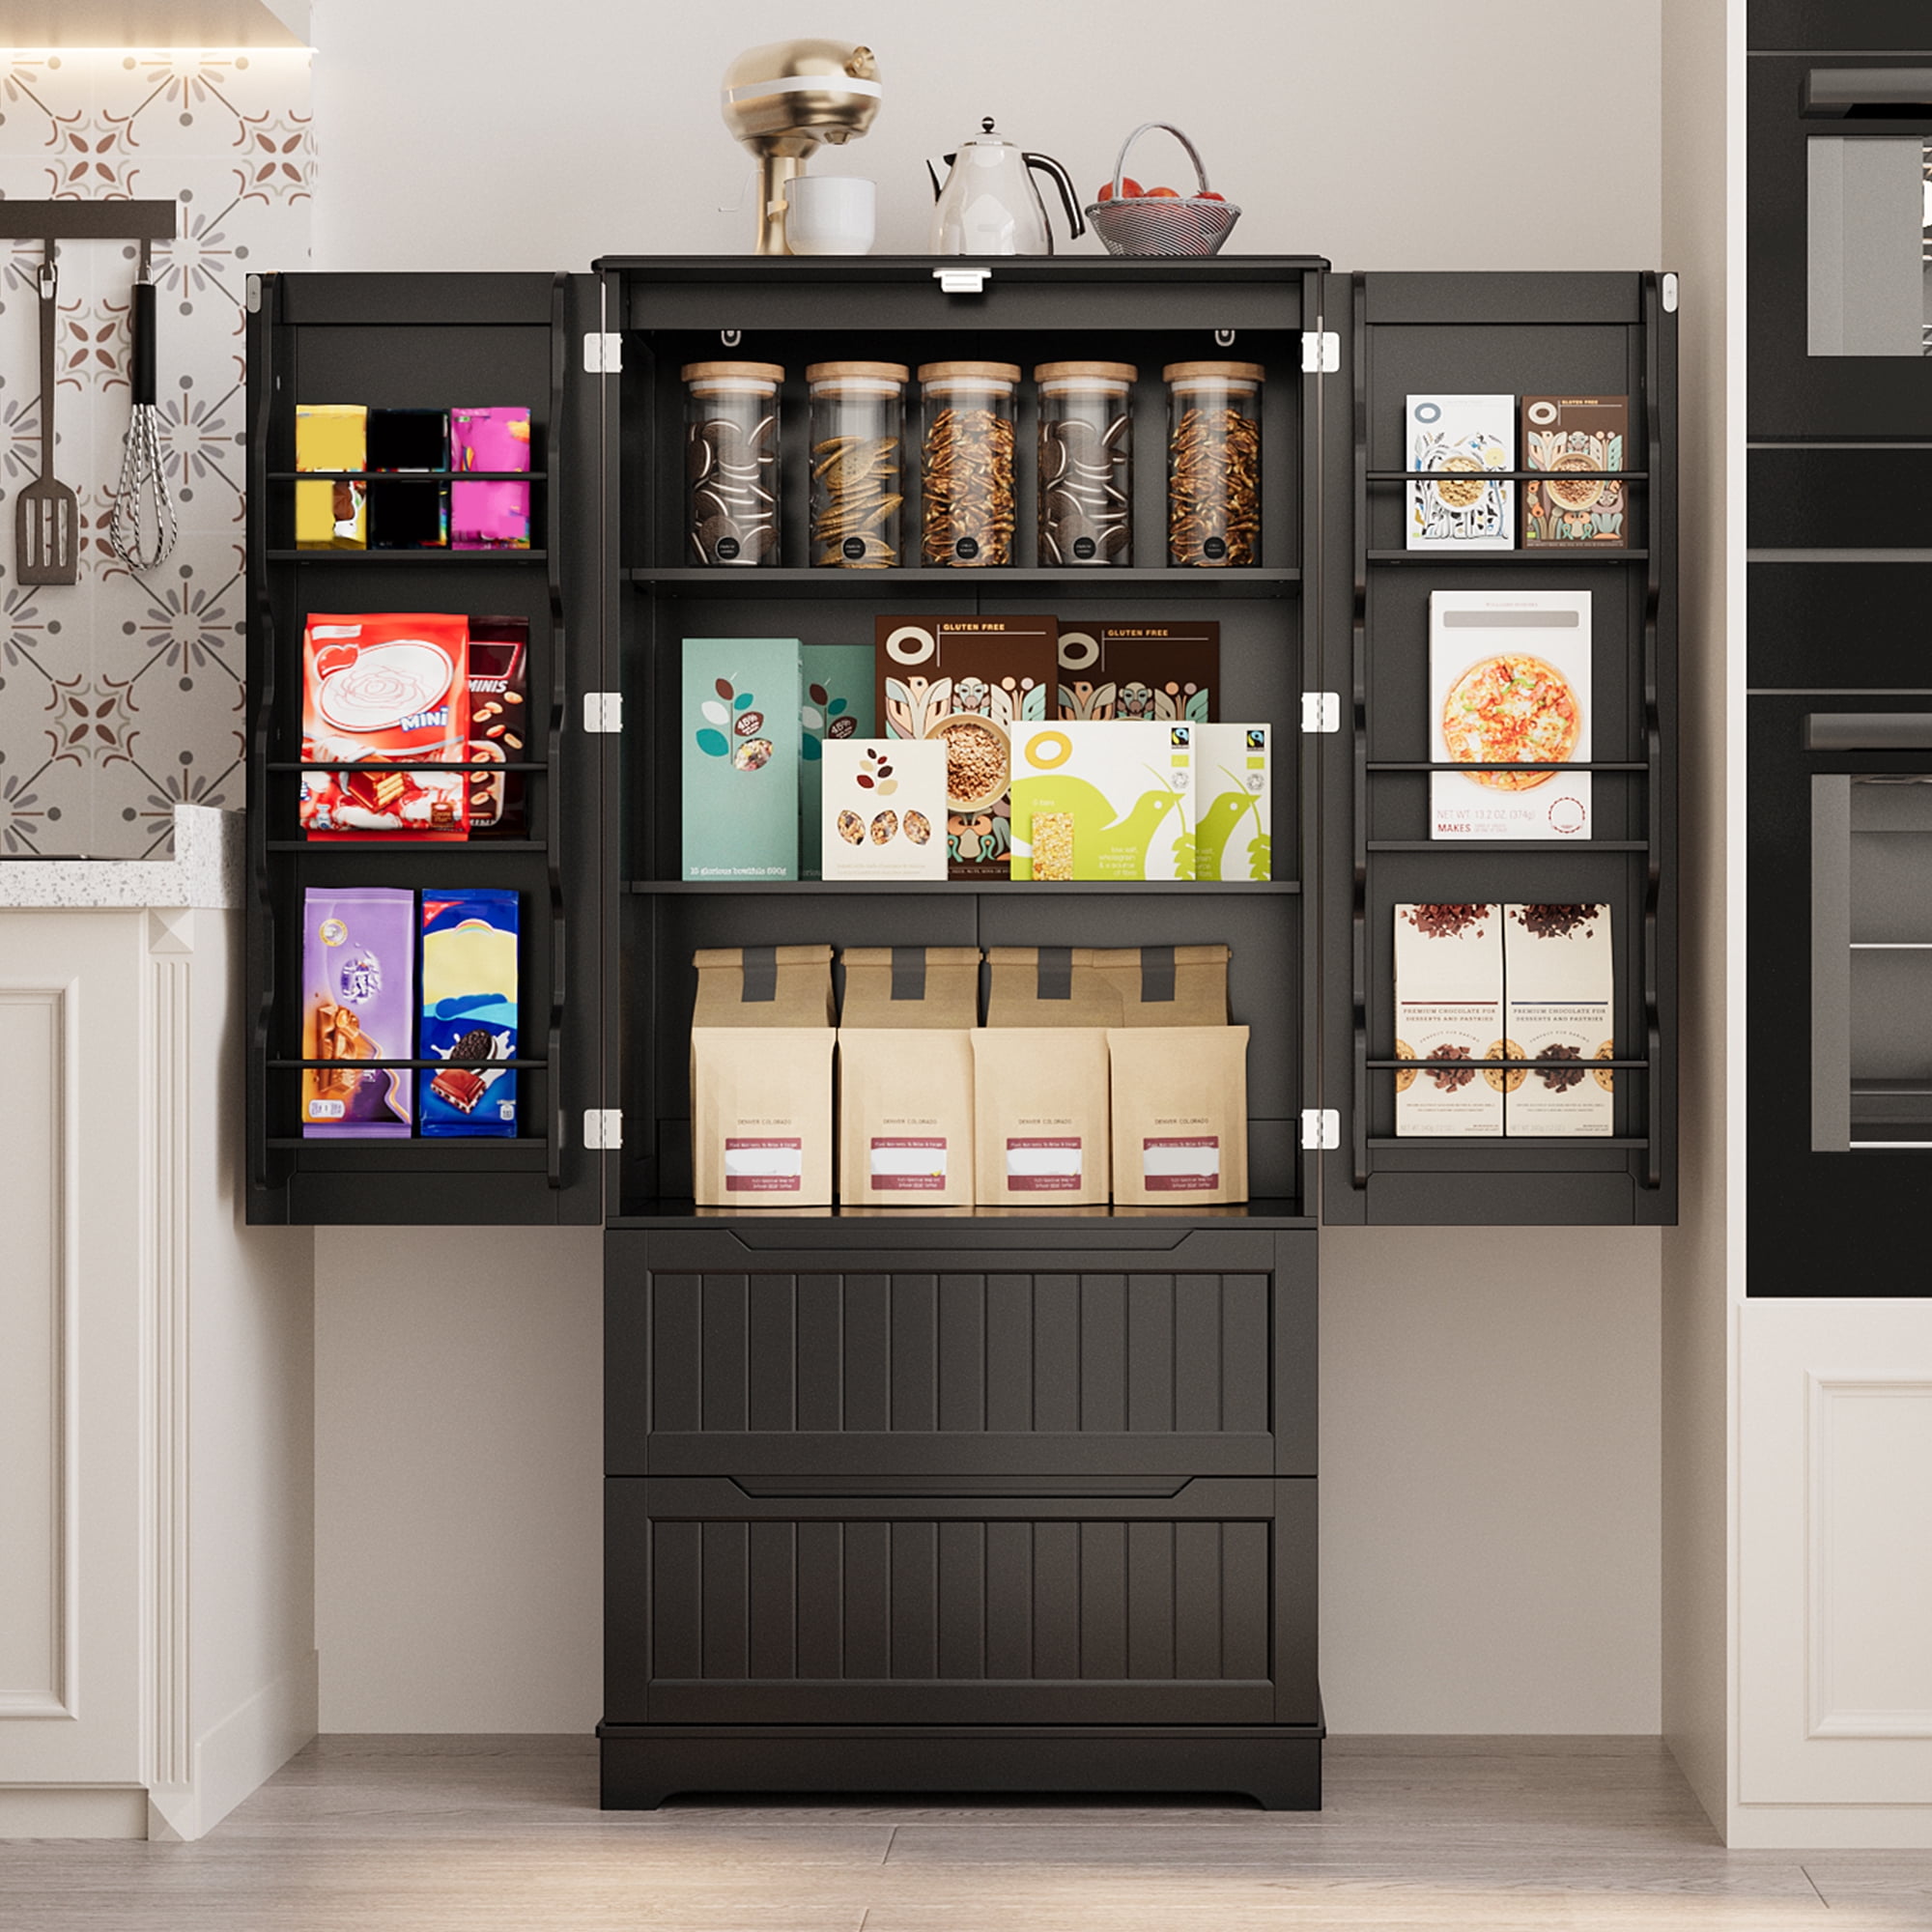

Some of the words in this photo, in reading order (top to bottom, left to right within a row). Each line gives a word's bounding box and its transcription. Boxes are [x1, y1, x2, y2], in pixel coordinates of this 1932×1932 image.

[469, 680, 509, 694] MINIS
[1436, 810, 1454, 819] NET
[1456, 810, 1469, 819] WT
[1437, 823, 1472, 833] MAKES
[700, 867, 732, 877] glorious
